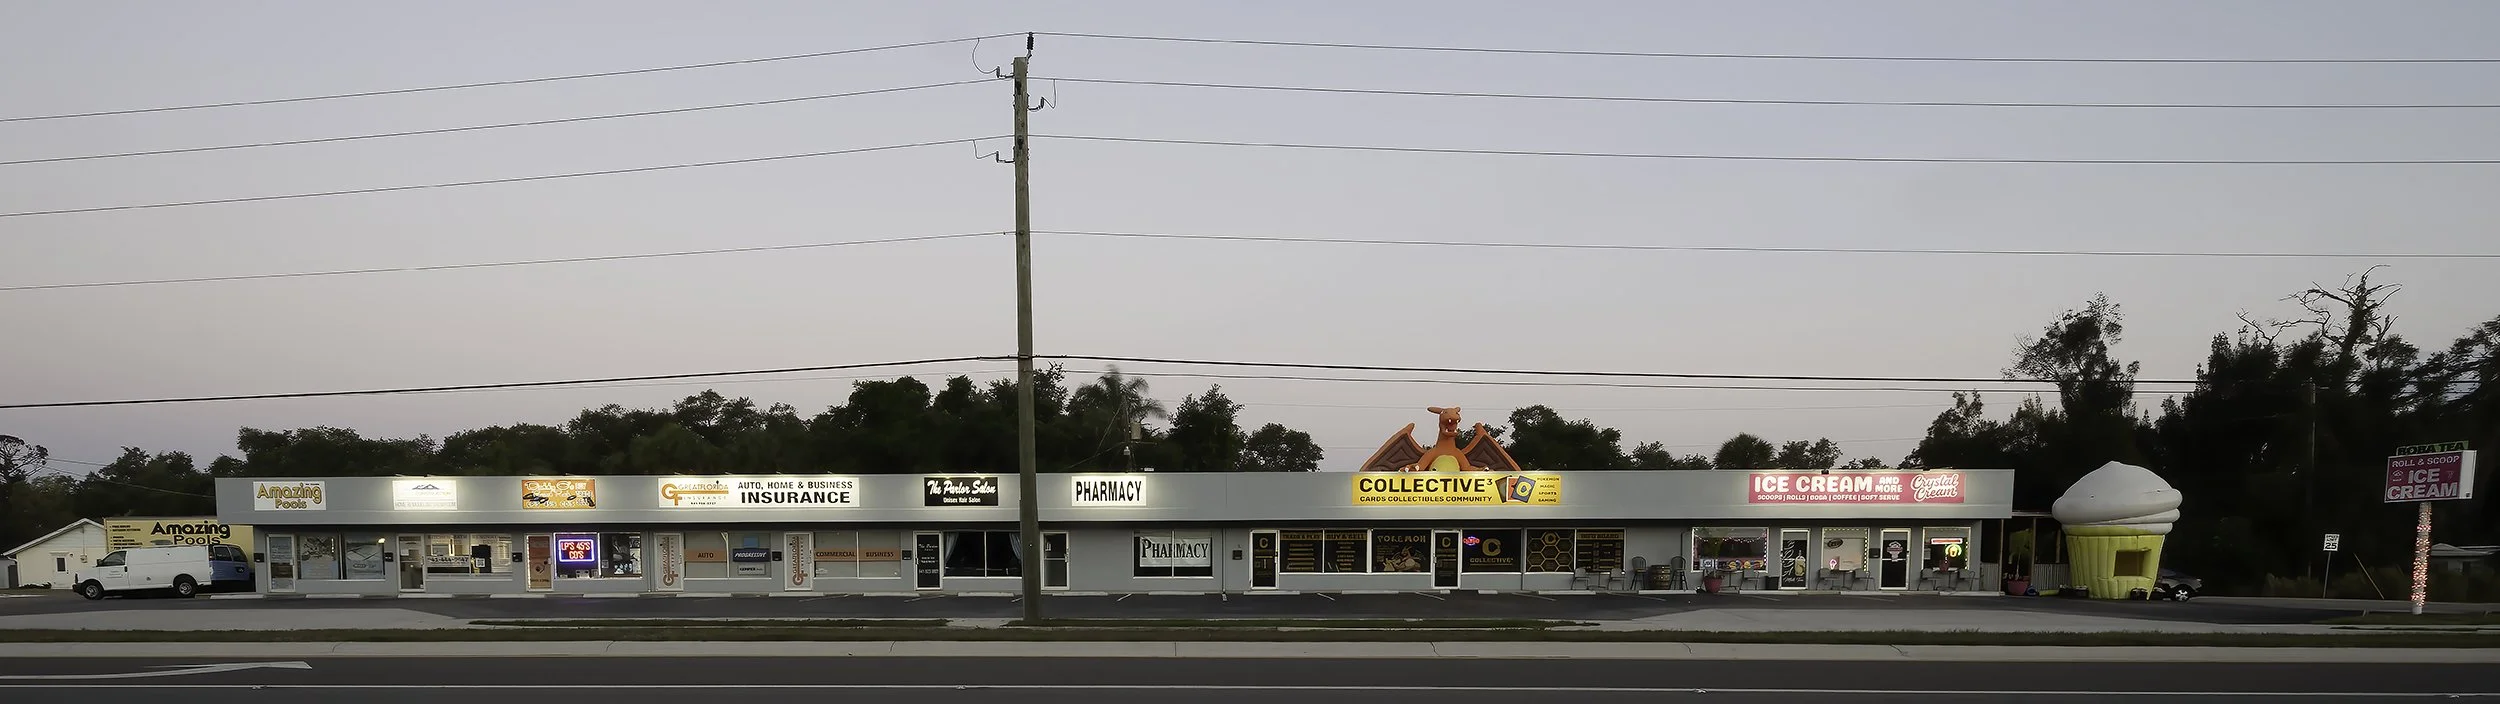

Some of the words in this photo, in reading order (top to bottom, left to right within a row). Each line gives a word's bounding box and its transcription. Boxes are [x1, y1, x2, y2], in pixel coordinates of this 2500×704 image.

[2439, 441, 2465, 452] TEA
[2392, 460, 2415, 468] ROLL
[2418, 458, 2424, 466] &
[2427, 456, 2460, 465] SCOOP
[1878, 477, 1900, 485] AND
[1911, 474, 1959, 489] Crystal
[2408, 468, 2440, 484] ICE
[738, 482, 764, 490] AUTO,
[768, 481, 794, 489] HOME
[798, 481, 804, 489] &
[808, 481, 853, 489] BUSINESS
[927, 480, 942, 494] The
[943, 480, 970, 494] Parlor
[972, 480, 996, 494] Salon
[1754, 476, 1789, 492] ICE
[1796, 476, 1872, 492] CREAM
[1874, 484, 1902, 492] MORE
[2387, 482, 2458, 500] CREAM
[257, 482, 322, 504] Amazing
[741, 492, 850, 504] INSURANCE
[1076, 481, 1142, 502] PHARMACY
[1914, 484, 1957, 502] Cream
[275, 499, 308, 509] Pools
[150, 520, 230, 539] Amazing
[174, 536, 221, 545] Pools
[560, 542, 575, 550] LP'S
[576, 542, 590, 550] 45'S
[1482, 538, 1501, 556] C
[1142, 538, 1208, 560] PHARMACY
